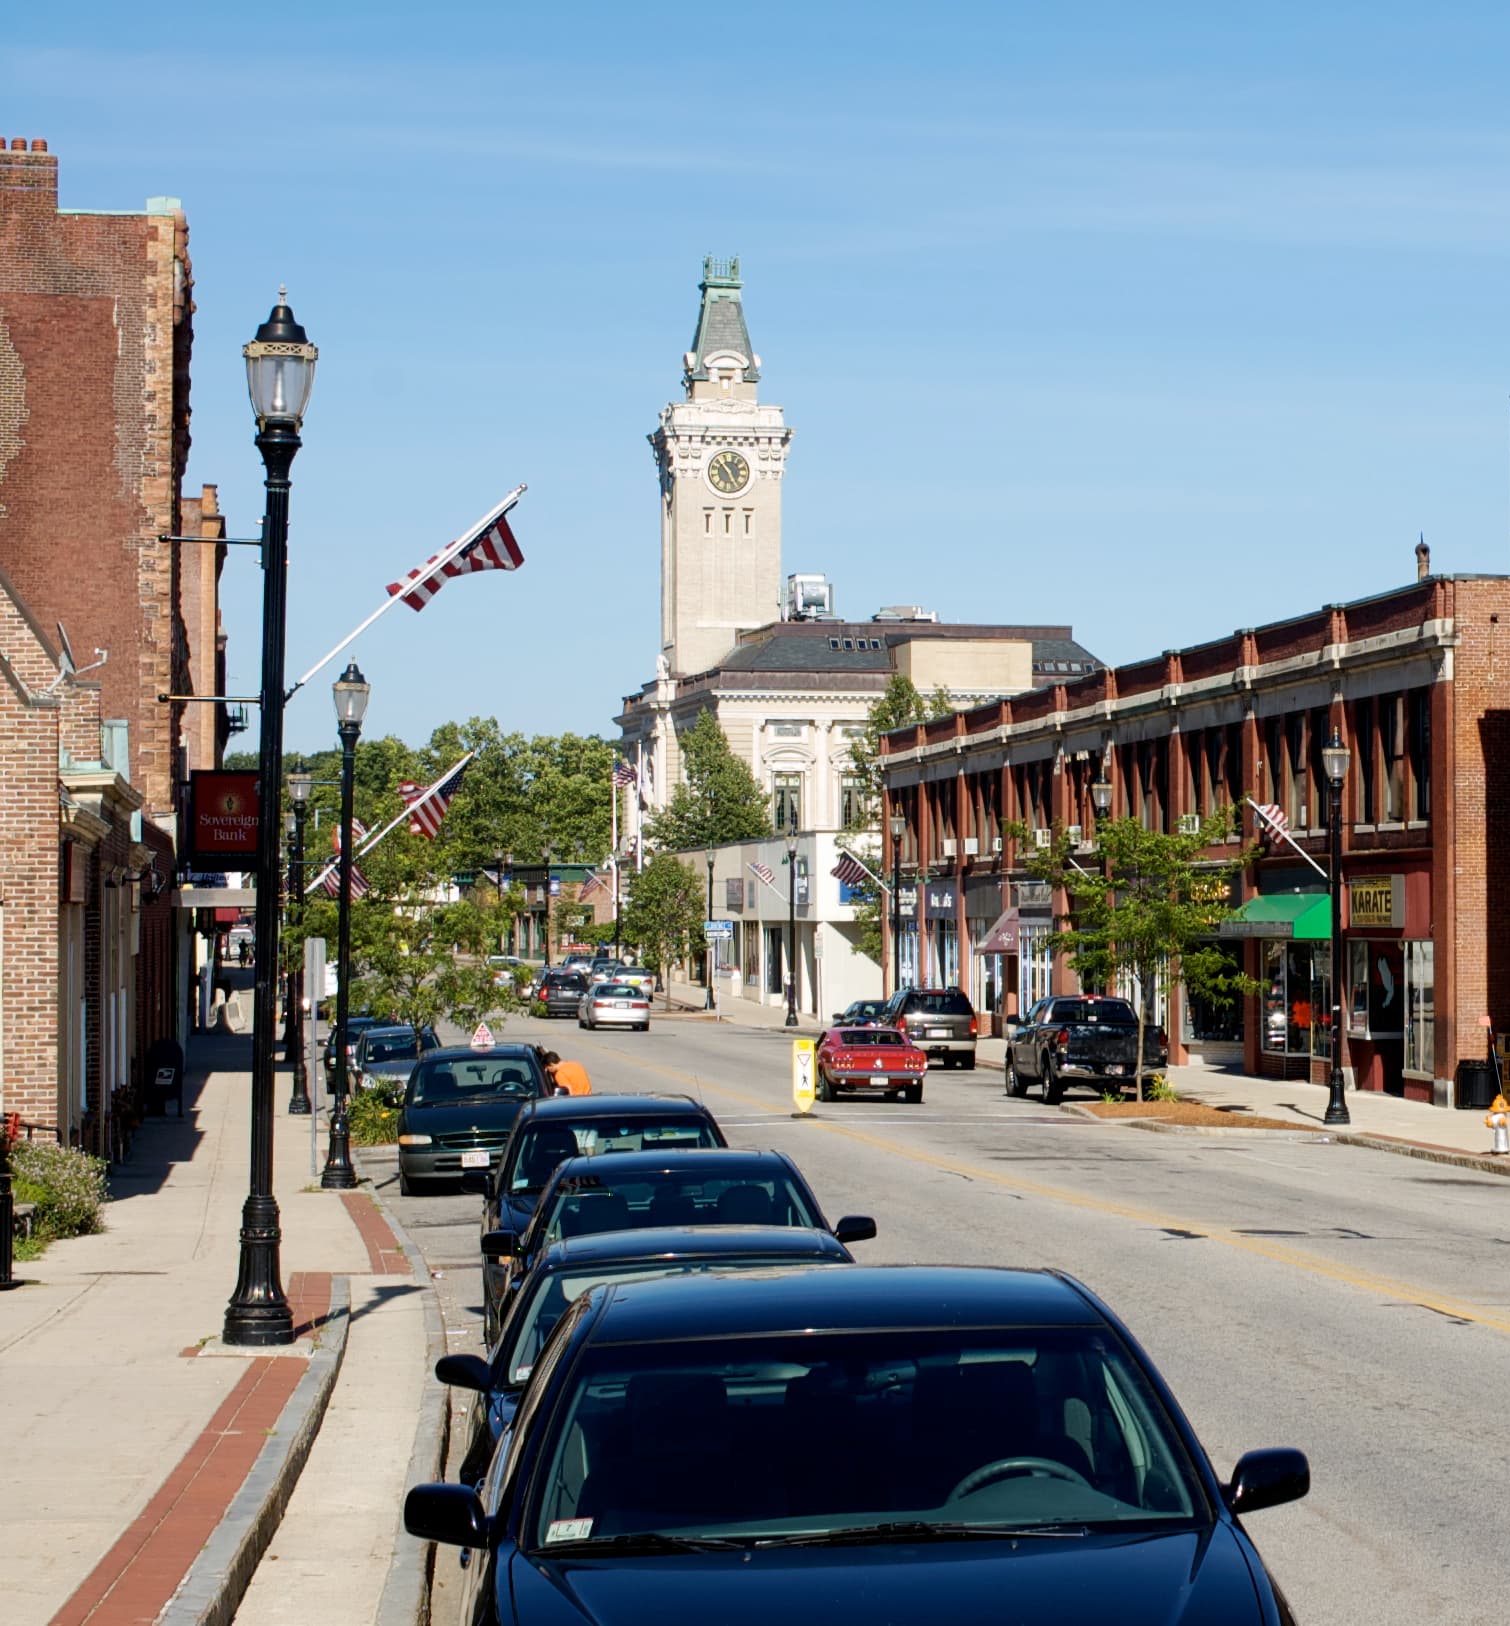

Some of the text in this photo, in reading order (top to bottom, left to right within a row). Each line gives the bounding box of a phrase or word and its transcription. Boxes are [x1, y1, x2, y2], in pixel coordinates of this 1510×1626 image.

[200, 814, 259, 829] Sovereign
[214, 829, 247, 841] Bank
[1352, 890, 1392, 913] KARATE
